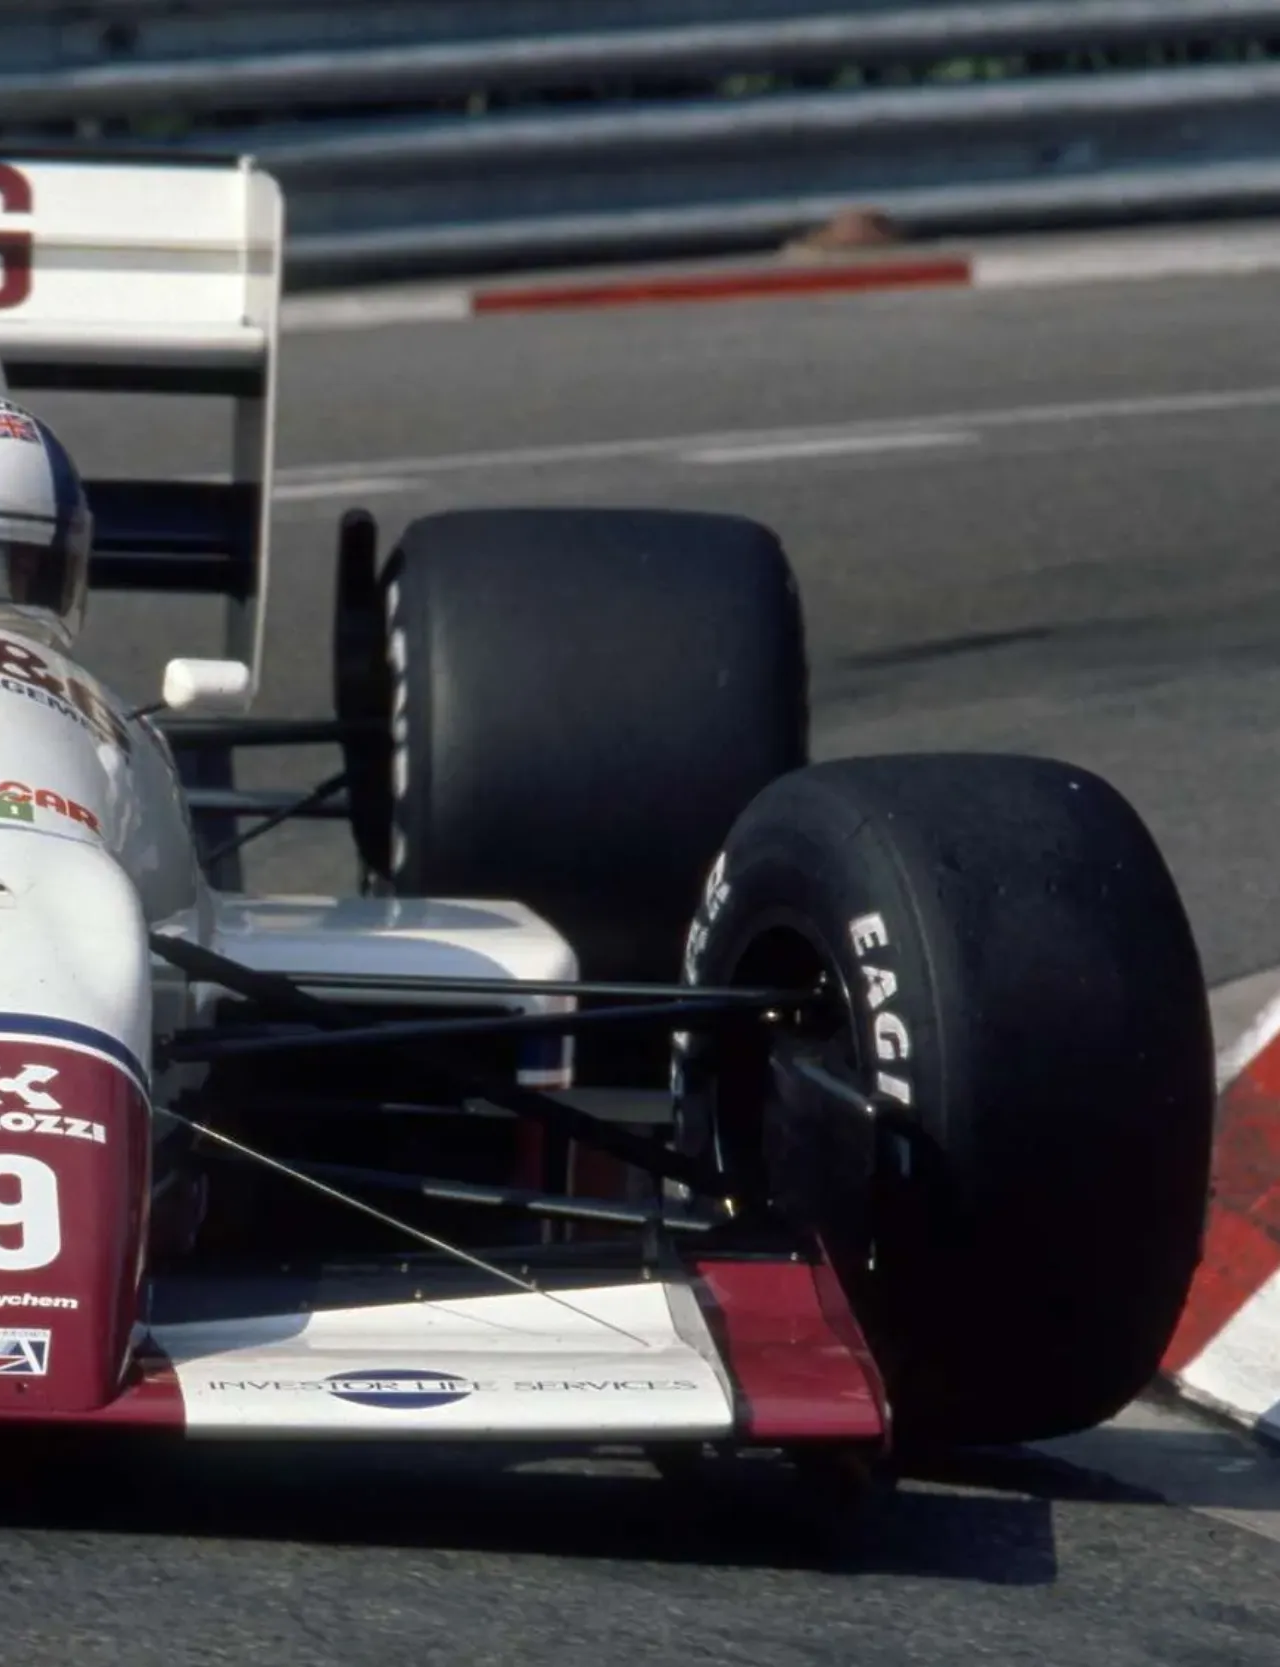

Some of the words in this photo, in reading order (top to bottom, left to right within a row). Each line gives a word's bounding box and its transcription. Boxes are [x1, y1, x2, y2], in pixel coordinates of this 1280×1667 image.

[208, 1380, 400, 1391] INVESTOR
[416, 1380, 501, 1391] LIFE
[513, 1380, 698, 1391] SERVICES
